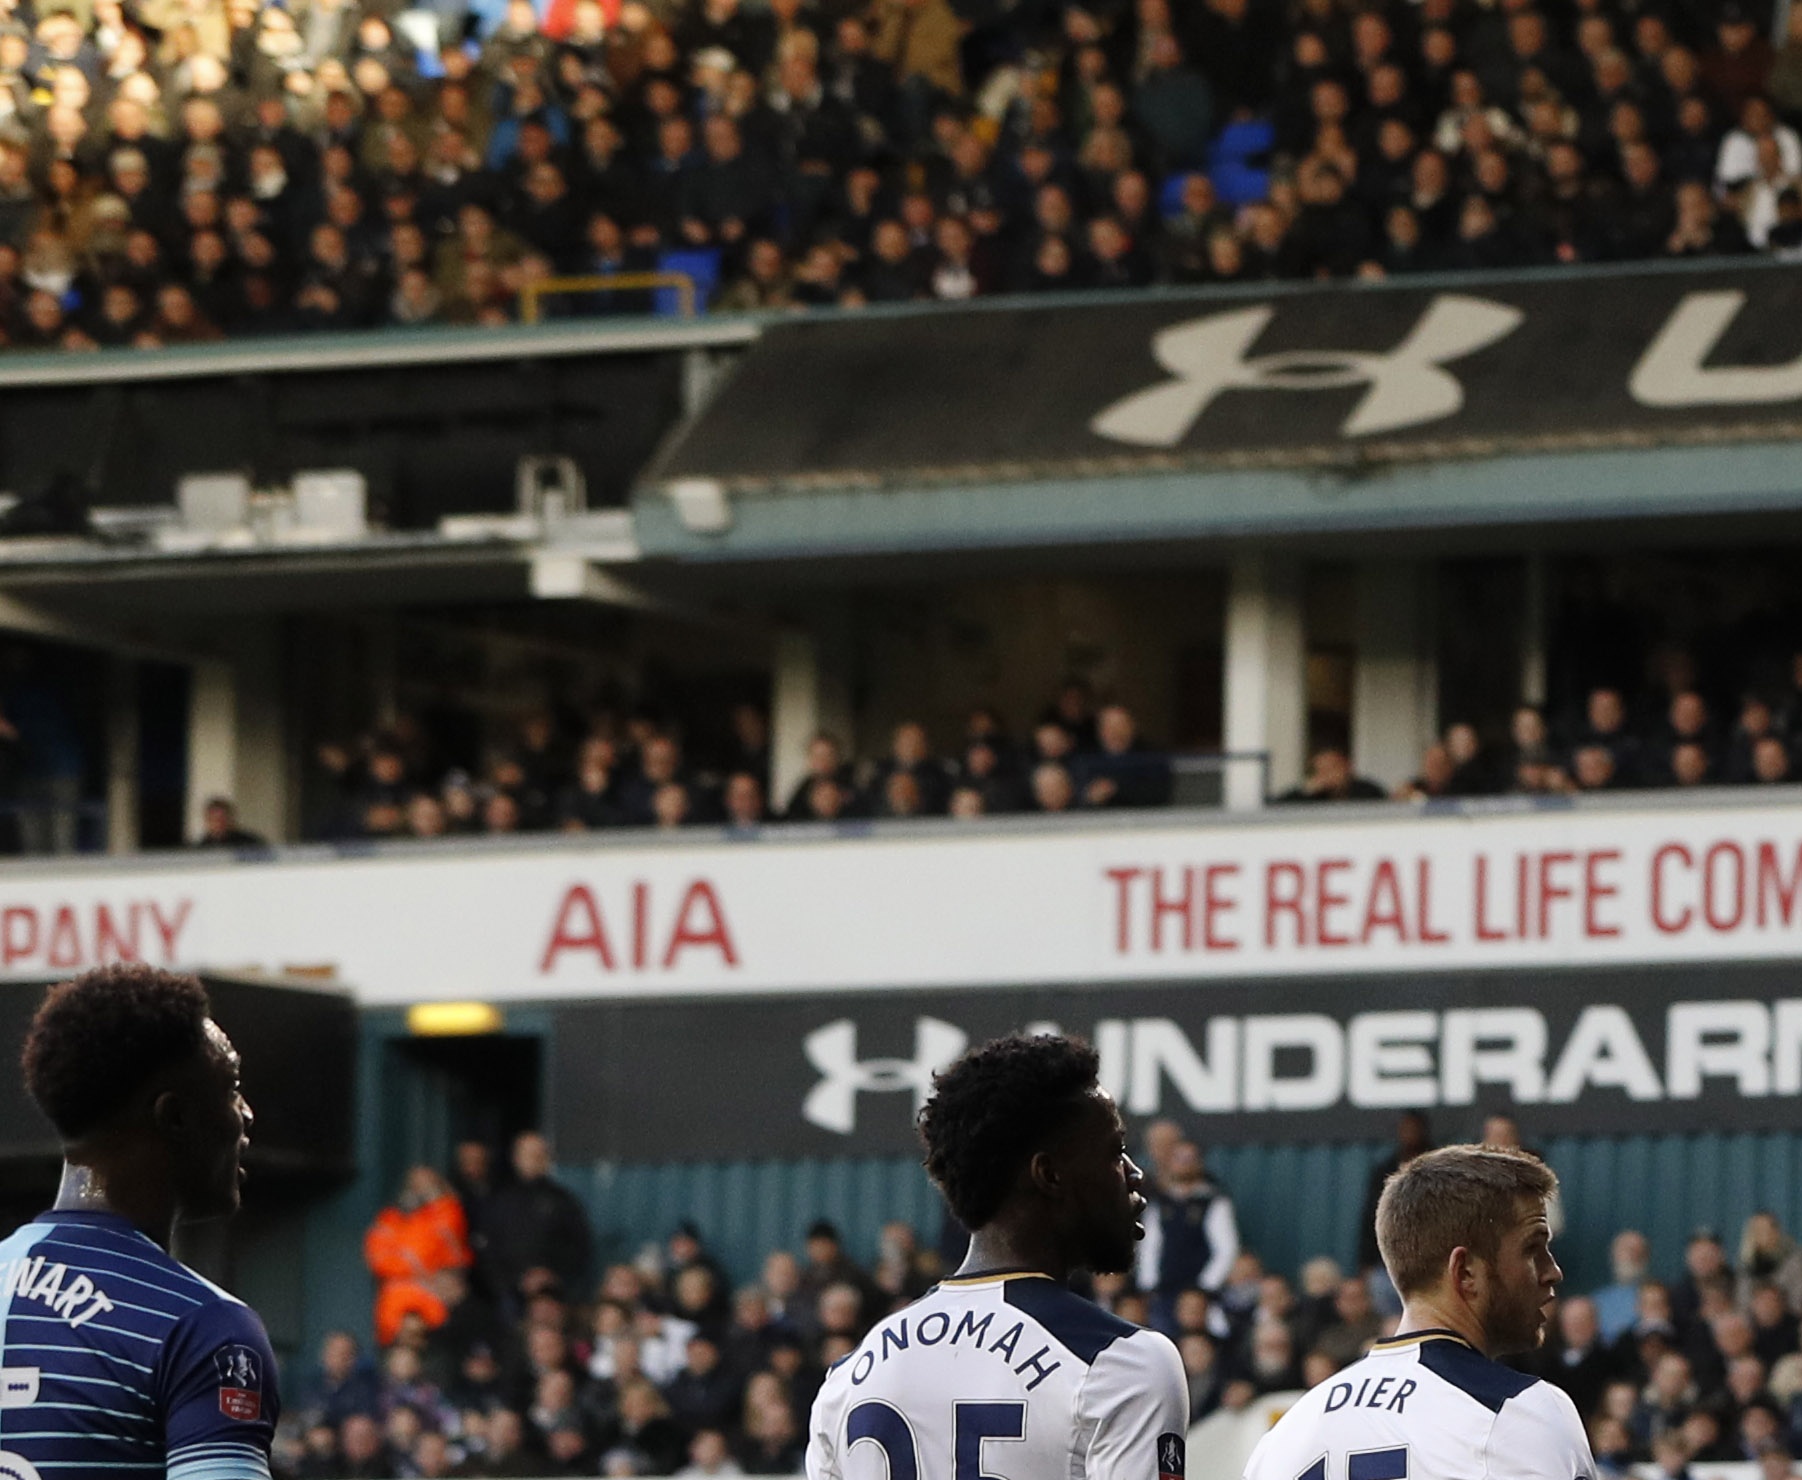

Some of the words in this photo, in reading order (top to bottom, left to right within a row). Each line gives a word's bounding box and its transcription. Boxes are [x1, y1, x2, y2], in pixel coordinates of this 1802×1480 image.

[540, 878, 740, 974] AIA
[1104, 864, 1240, 953] THE
[1263, 857, 1450, 948] REAL
[1474, 848, 1621, 943] LIFE
[0, 1255, 114, 1329] WART
[850, 1309, 1061, 1393] ONOMAH
[1322, 1376, 1418, 1415] DIER
